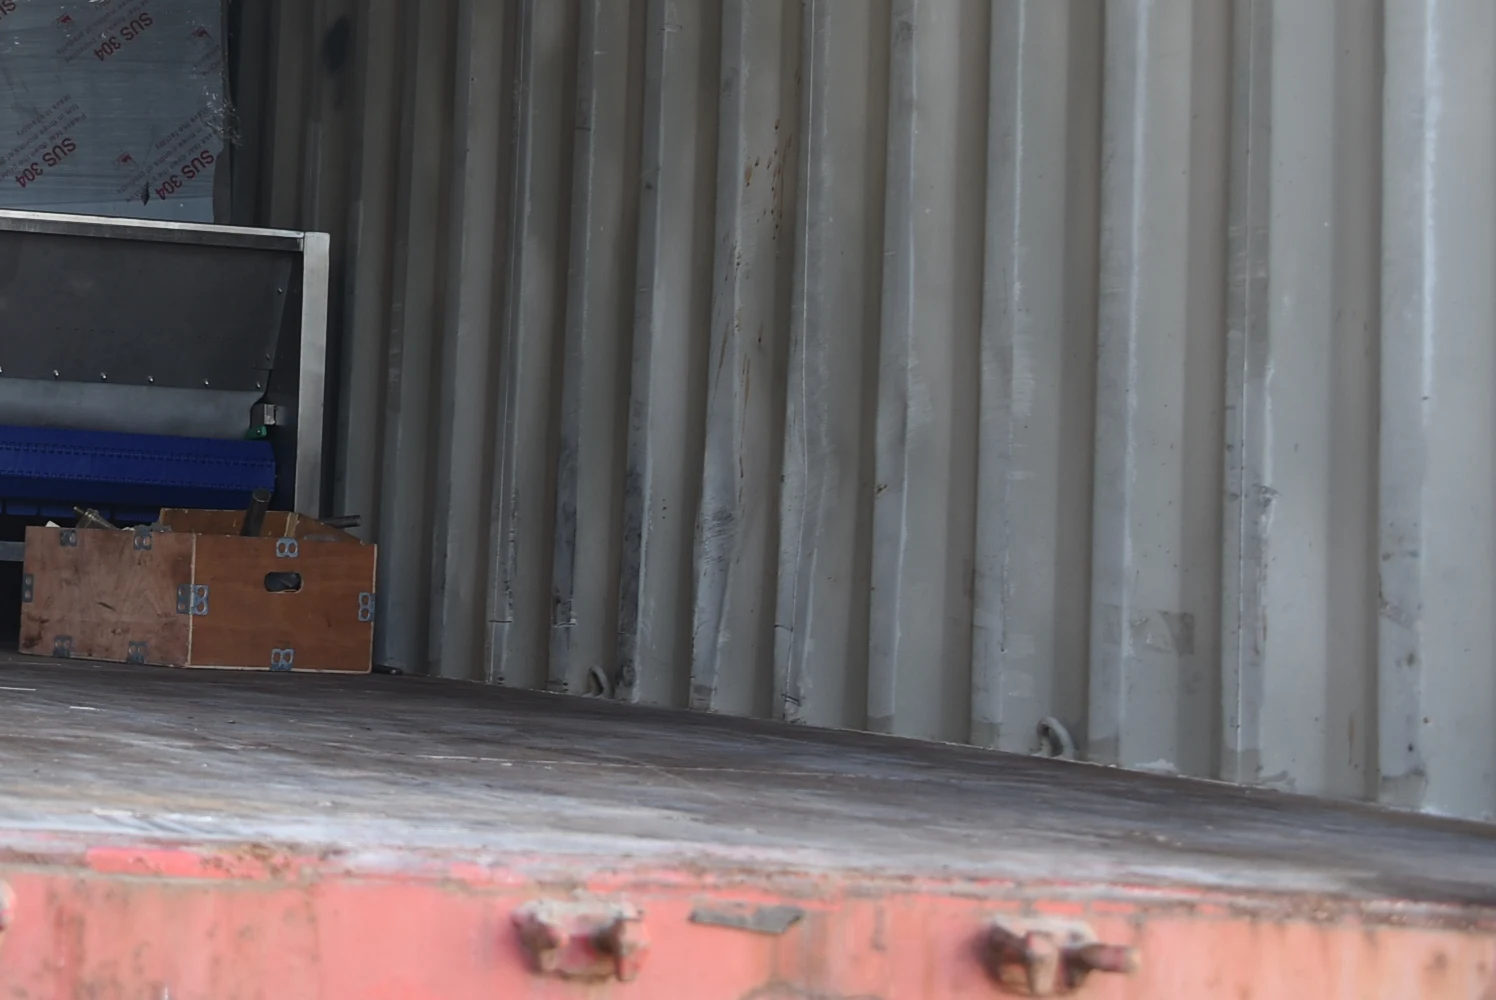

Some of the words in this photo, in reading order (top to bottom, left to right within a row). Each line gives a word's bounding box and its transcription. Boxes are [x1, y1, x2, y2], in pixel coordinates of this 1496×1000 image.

[119, 12, 152, 41] SUS
[93, 37, 120, 60] 304
[42, 137, 76, 167] SUS
[180, 150, 214, 179] SUS
[14, 162, 43, 187] 304
[154, 175, 181, 199] 304
